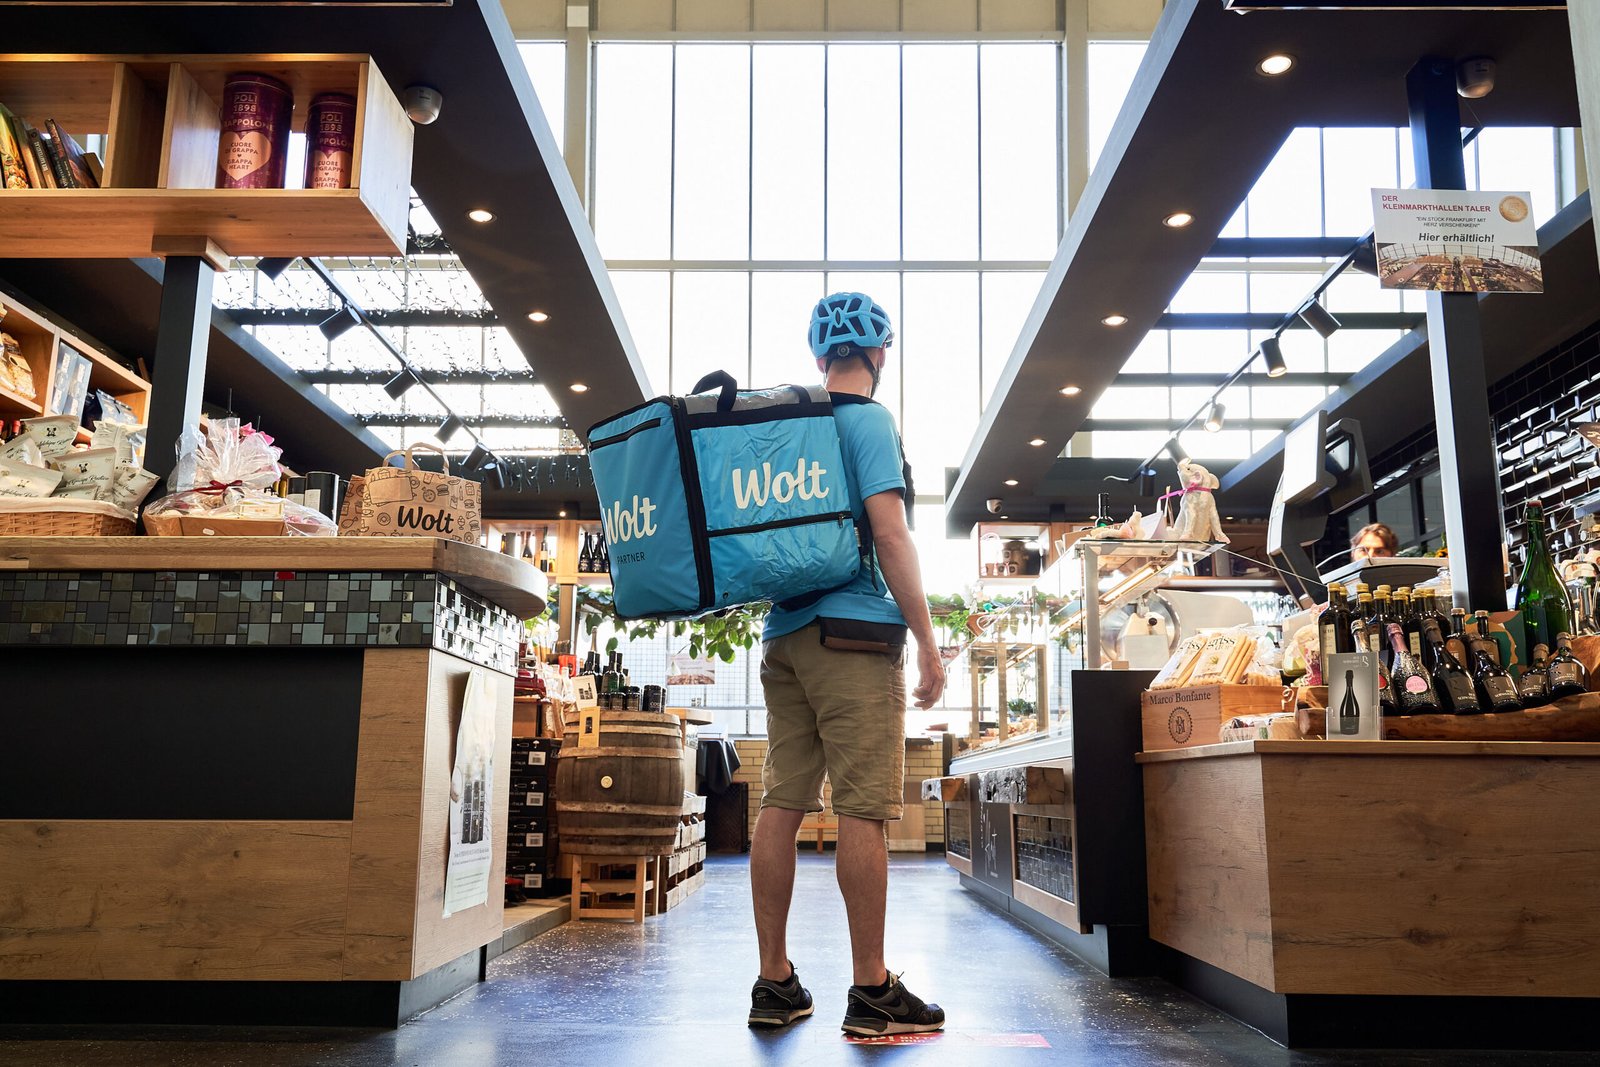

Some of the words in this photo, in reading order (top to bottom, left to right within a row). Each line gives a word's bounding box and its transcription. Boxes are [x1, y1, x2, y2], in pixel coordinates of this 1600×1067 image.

[234, 94, 258, 103] POLI
[234, 104, 257, 112] 1898
[321, 114, 343, 122] POLI
[321, 124, 342, 132] 1898
[232, 147, 259, 155] GRAPPA
[319, 165, 345, 173] GRAPPA
[1383, 203, 1464, 212] KLEINMARKTHALLEN
[1465, 205, 1491, 213] TALER
[1419, 232, 1440, 242] Hier
[1443, 233, 1494, 243] erhältlich!
[732, 458, 829, 509] Wolt
[397, 505, 454, 534] Wolt
[603, 495, 657, 546] Wolt
[617, 552, 645, 564] PARTNER
[1149, 695, 1174, 705] Marco
[1175, 691, 1212, 703] Bonfante
